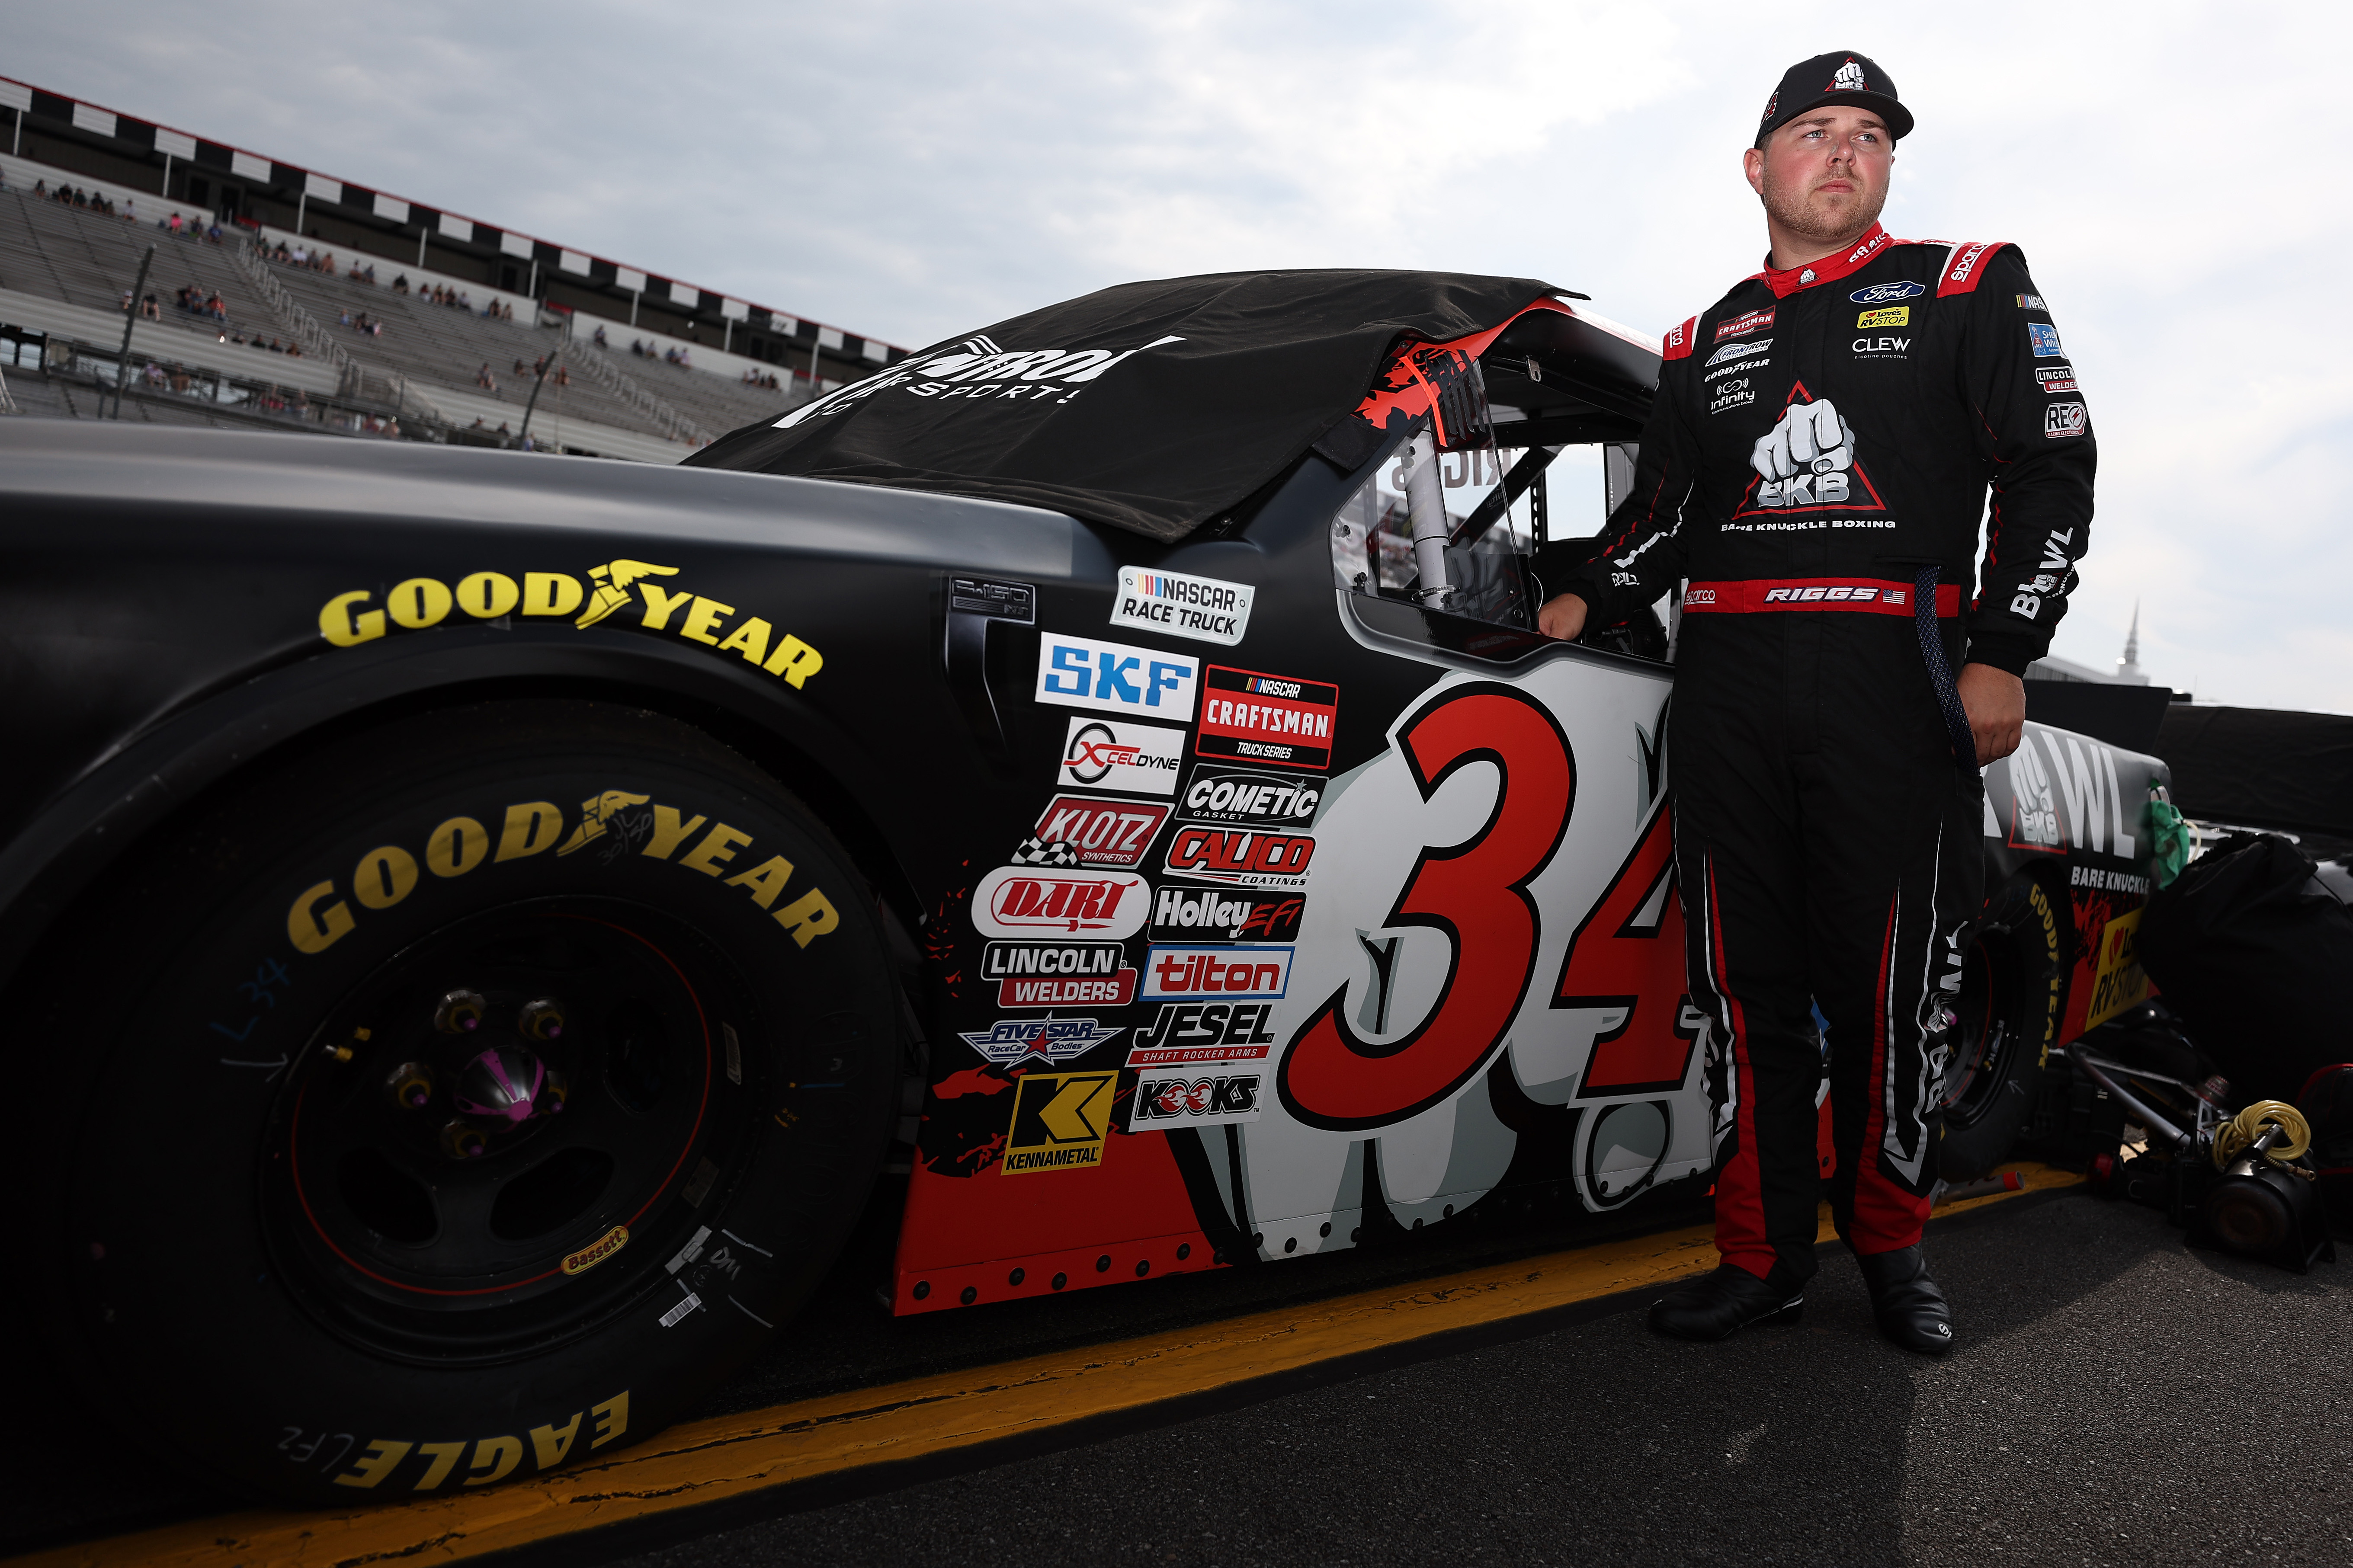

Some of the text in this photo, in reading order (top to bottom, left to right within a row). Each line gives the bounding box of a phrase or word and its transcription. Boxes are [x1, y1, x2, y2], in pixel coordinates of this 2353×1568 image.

[1950, 244, 1985, 282] sparc
[1863, 285, 1913, 301] Ford
[2027, 296, 2046, 310] NAS
[1718, 314, 1772, 335] CRAFTSMAN
[1741, 310, 1759, 321] NASCAR
[1670, 325, 1683, 349] arco
[1852, 337, 1911, 352] CLEW
[2048, 381, 2078, 390] WELDER
[1711, 390, 1755, 410] Infinity
[1757, 472, 1850, 508] BKB
[1721, 520, 1896, 532] BARE KNUCKLE BOXING
[1162, 577, 1236, 611] NASCAR
[1684, 589, 1716, 605] sparco
[1763, 587, 1881, 603] RIGGS
[1122, 599, 1238, 635] RACE TRUCK
[1045, 645, 1191, 707] SKF
[1259, 679, 1301, 698] NASCAR
[1207, 699, 1329, 738] CRAFTSMAN
[1063, 741, 1180, 771] XCELDYNE
[1237, 742, 1292, 759] TRUCK SERIES
[1187, 780, 1318, 818] COMETIC
[1193, 810, 1245, 821] GASKET
[1043, 807, 1157, 852] KLOTZ
[1081, 850, 1134, 864] SYNTHETICS
[1168, 829, 1316, 873] CALICO
[1241, 875, 1308, 886] COATINGS
[2071, 866, 2150, 895] BARE KNUCKLE
[998, 879, 1138, 920] DART
[1278, 680, 1709, 1132] 34
[1154, 890, 1251, 938] Holley
[991, 947, 1115, 973] LINCOLN
[1155, 954, 1280, 992] tilton
[1015, 980, 1119, 1002] WELDERS
[991, 1021, 1095, 1040] FIVE STAR
[1134, 1004, 1275, 1049] JESEL
[987, 1041, 1083, 1053] RaceCar Bodies
[1142, 1047, 1258, 1062] SHAFT ROCKER ARMS
[1135, 1075, 1261, 1120] KOOKS
[1006, 1148, 1099, 1171] KENNAMETAL
[568, 1229, 623, 1270] Bassett
[333, 1390, 629, 1491] EAGLE
